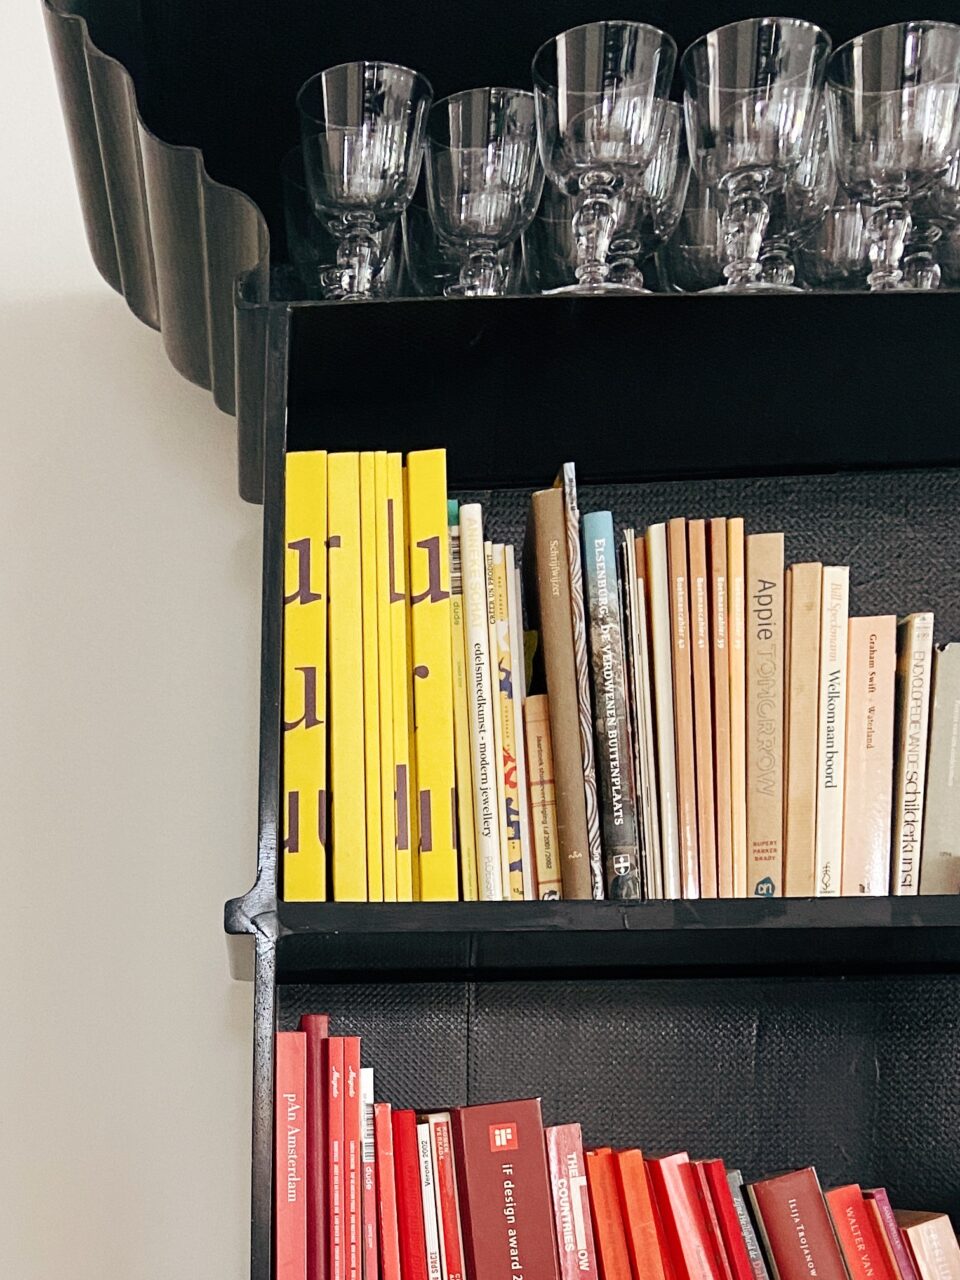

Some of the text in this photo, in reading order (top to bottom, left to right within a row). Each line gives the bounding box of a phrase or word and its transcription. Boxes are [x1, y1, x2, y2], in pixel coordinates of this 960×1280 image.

[548, 540, 564, 597] Schrijfwijzer
[453, 602, 462, 625] dude
[599, 624, 612, 643] DE
[600, 645, 619, 727] VERDWENEN
[753, 578, 777, 797] Appie TOMORROW
[866, 633, 878, 694] Graham Swift
[825, 668, 841, 730] Welkom
[474, 642, 498, 838] edelsmeedkunst modern jewellery
[866, 705, 876, 750] Waterland
[606, 729, 625, 826] BUITENPLAATS
[823, 756, 839, 789] boord
[286, 1124, 302, 1203] Amsterdam
[421, 1140, 432, 1187] Verona 2002
[501, 1163, 514, 1175] iF
[566, 1152, 579, 1178] THE
[502, 1179, 519, 1224] design
[557, 1178, 575, 1253] COUNTRIES
[429, 1251, 440, 1274] SPACE
[507, 1227, 523, 1270] award
[748, 1249, 759, 1260] de
[787, 1197, 819, 1277] ILIJA TROJANOW
[845, 1205, 866, 1252] WALTER
[860, 1253, 876, 1277] VAN
